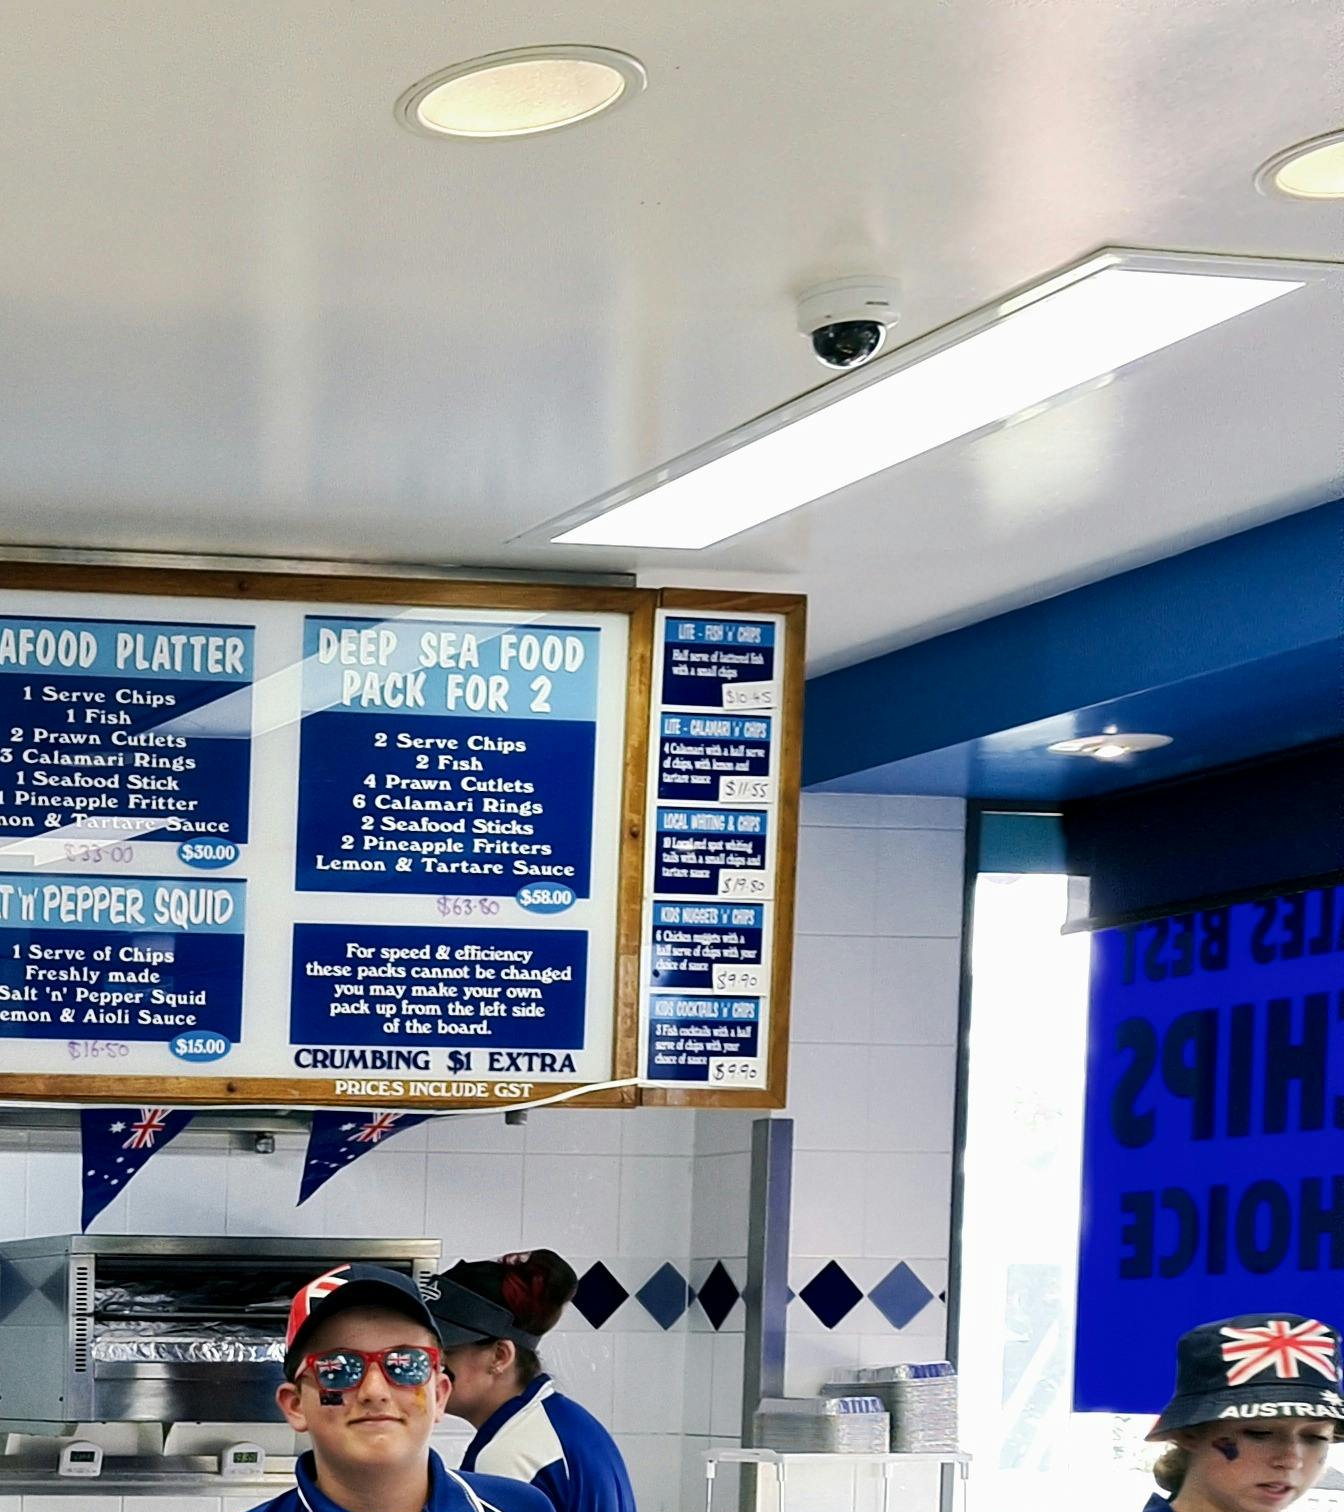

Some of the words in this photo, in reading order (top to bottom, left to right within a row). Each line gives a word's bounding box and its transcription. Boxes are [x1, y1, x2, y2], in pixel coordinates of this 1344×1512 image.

[115, 633, 244, 674] PLATTER
[318, 628, 397, 665] DEEP
[419, 632, 479, 669] SEA
[500, 635, 585, 673] FOOD
[341, 670, 427, 708] PACK
[446, 675, 510, 712] FOR
[530, 675, 552, 713] 2
[182, 844, 235, 861] $30.00
[43, 884, 146, 924] PEPPER
[154, 884, 234, 930] SQUID
[520, 889, 572, 906] $58.00
[347, 943, 375, 958] For
[381, 945, 430, 962] speed
[436, 945, 450, 960] &
[455, 945, 533, 964] efficiency
[306, 961, 351, 976] these
[357, 963, 406, 980] packs
[411, 966, 469, 978] cannot
[476, 965, 495, 979] be
[501, 965, 571, 983] changed
[176, 1039, 225, 1055] $15.00
[295, 1049, 431, 1071] CRUMBING
[446, 1050, 472, 1074] $1
[488, 1052, 576, 1074] EXTRA
[335, 1080, 404, 1096] PRICES
[409, 1081, 489, 1098] INCLUDE
[494, 1083, 534, 1098] GST
